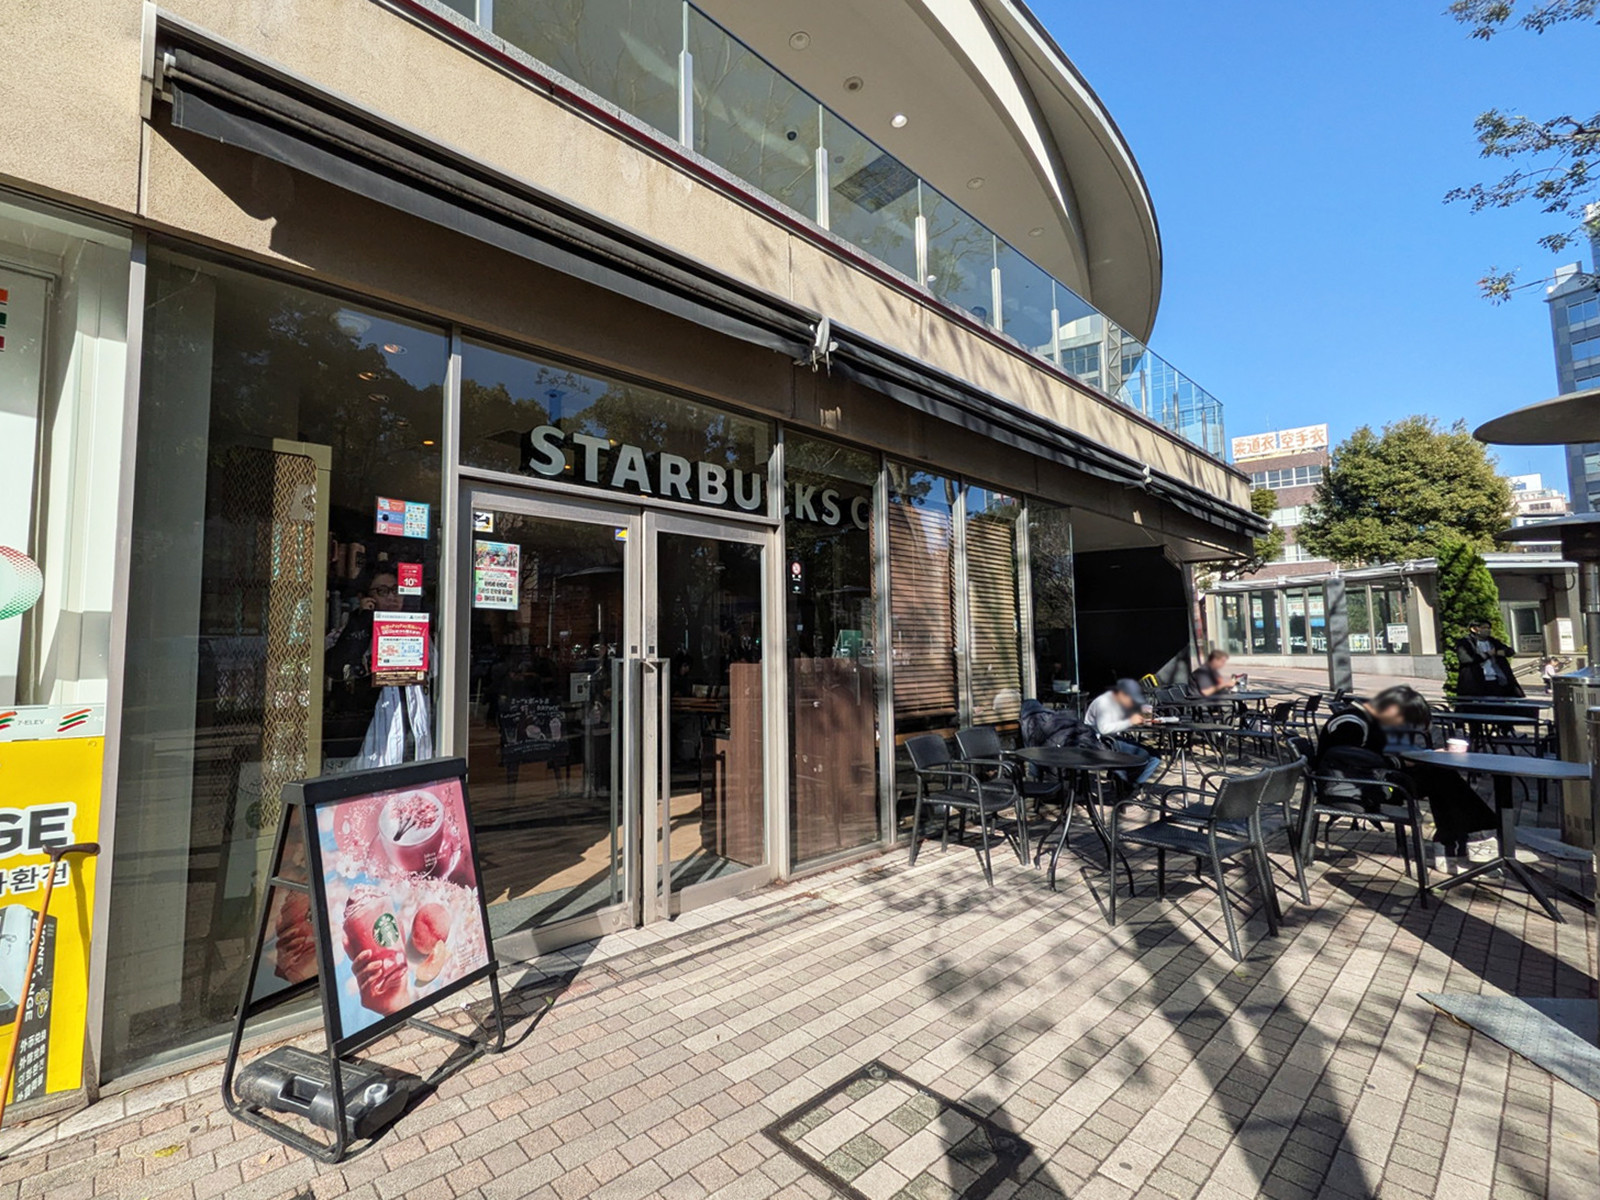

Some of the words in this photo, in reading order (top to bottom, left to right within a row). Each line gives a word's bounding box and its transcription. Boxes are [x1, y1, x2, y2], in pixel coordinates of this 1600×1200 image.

[1234, 435, 1275, 456] 柔道衣
[1281, 428, 1325, 449] 空手衣
[529, 425, 841, 526] STARBUKS
